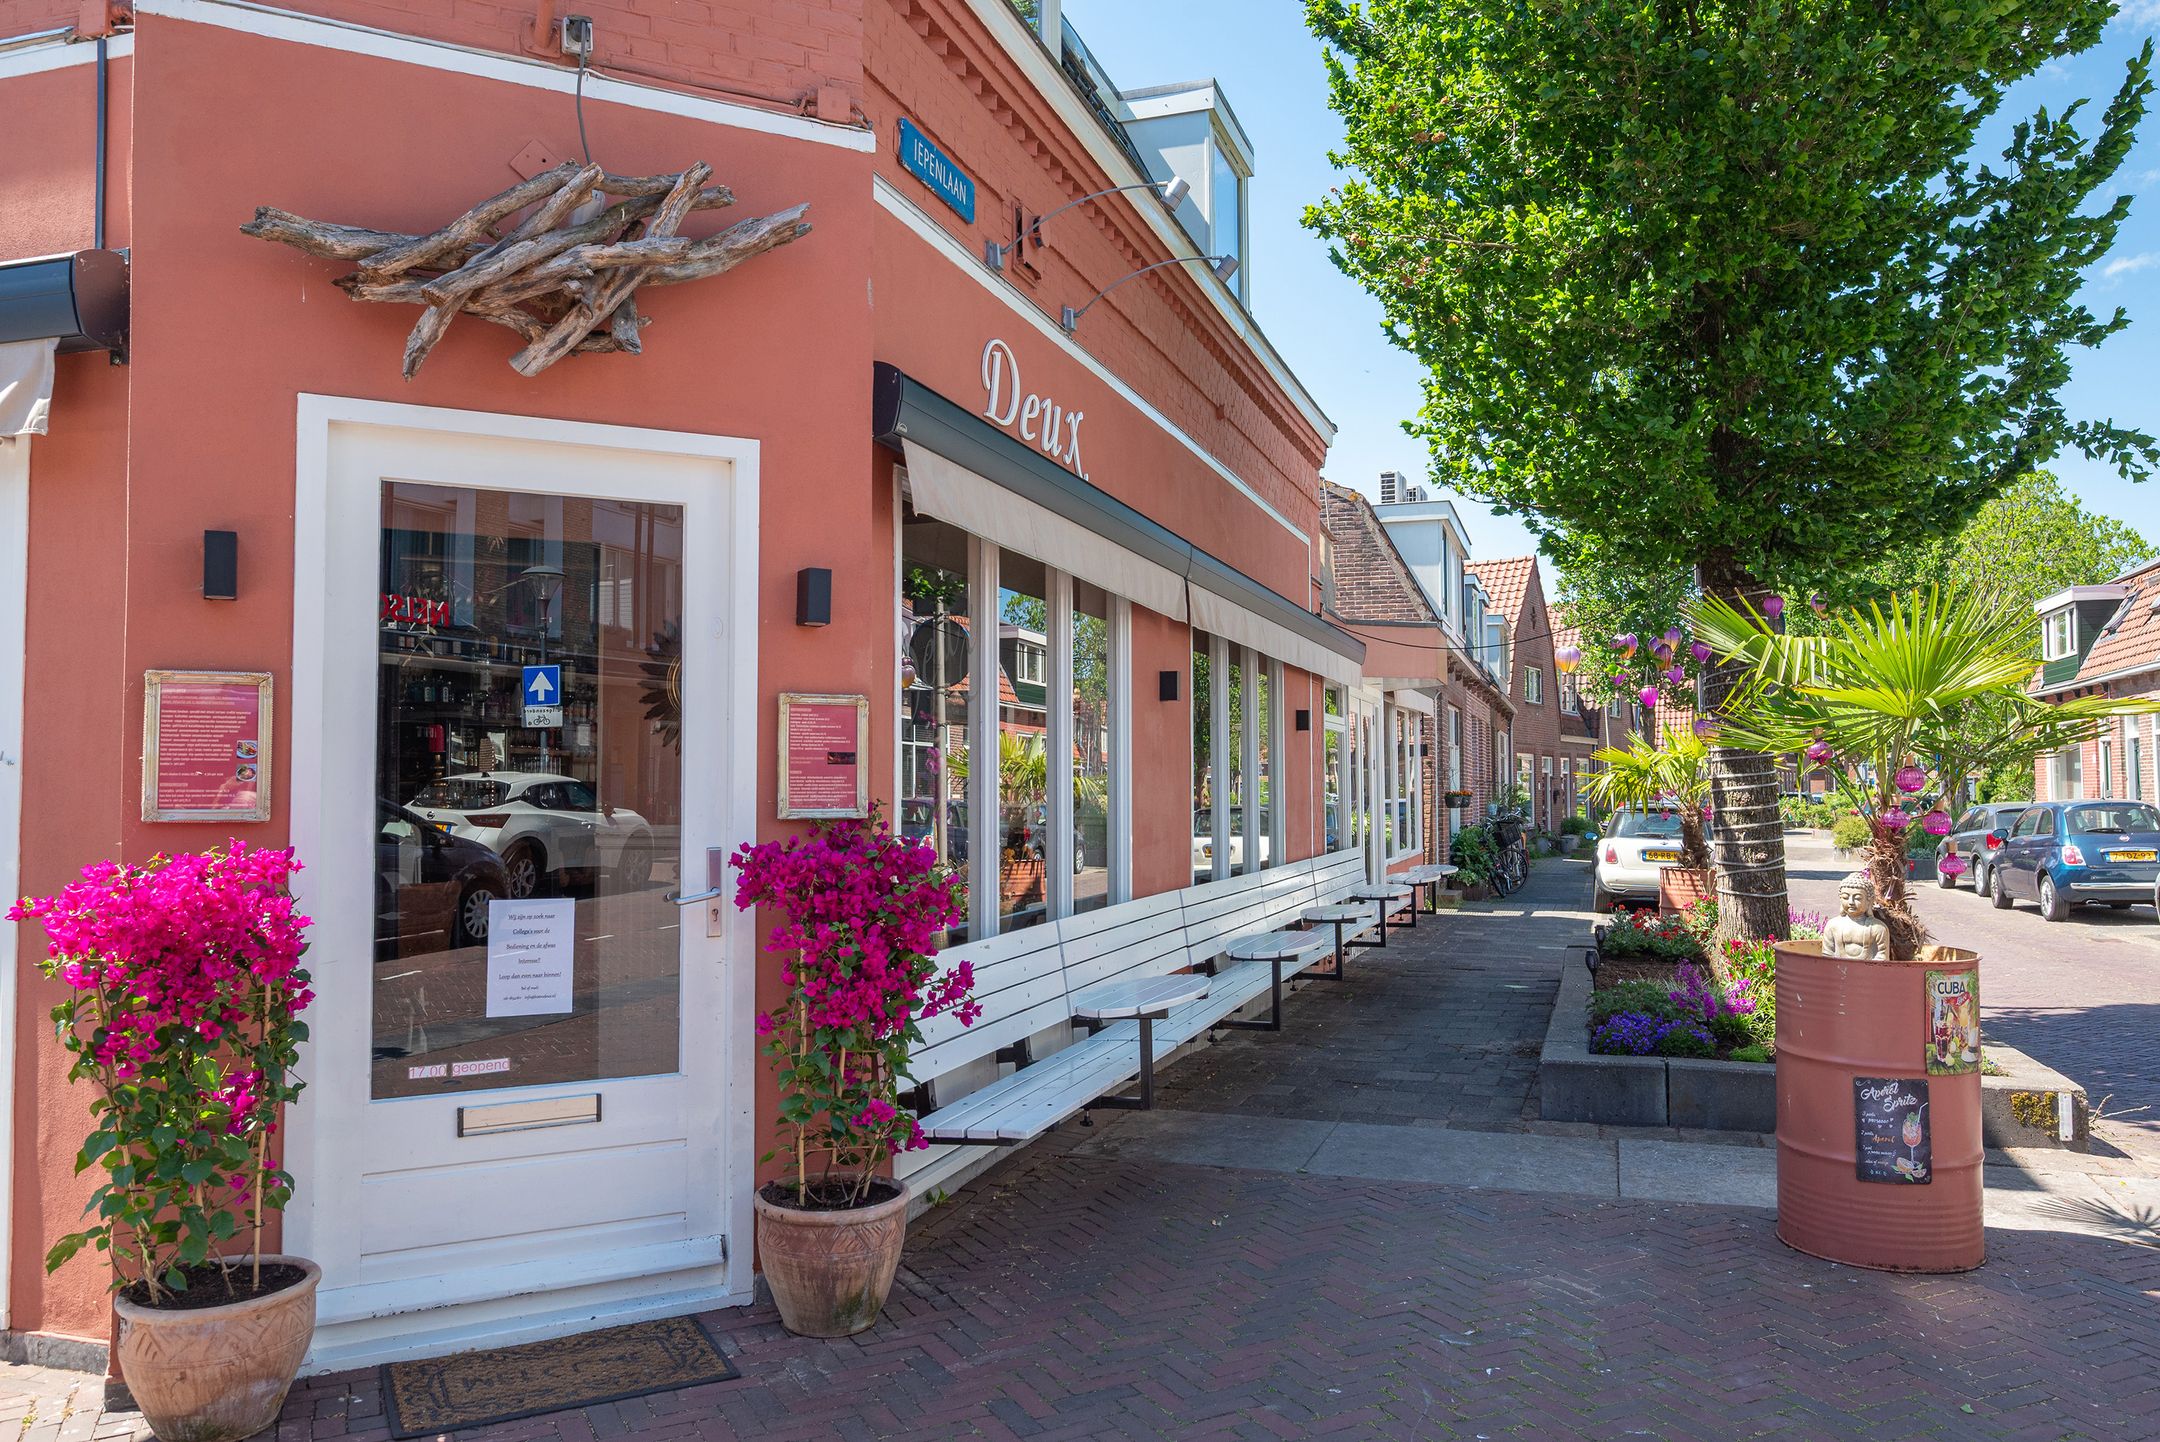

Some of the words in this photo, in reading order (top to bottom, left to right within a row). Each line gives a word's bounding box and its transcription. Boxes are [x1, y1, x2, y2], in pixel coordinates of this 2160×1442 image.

[914, 138, 967, 205] IEPENLAAN
[981, 338, 1089, 481] Deux
[1937, 981, 1966, 995] CUBA
[1860, 1081, 1899, 1100] Aperol
